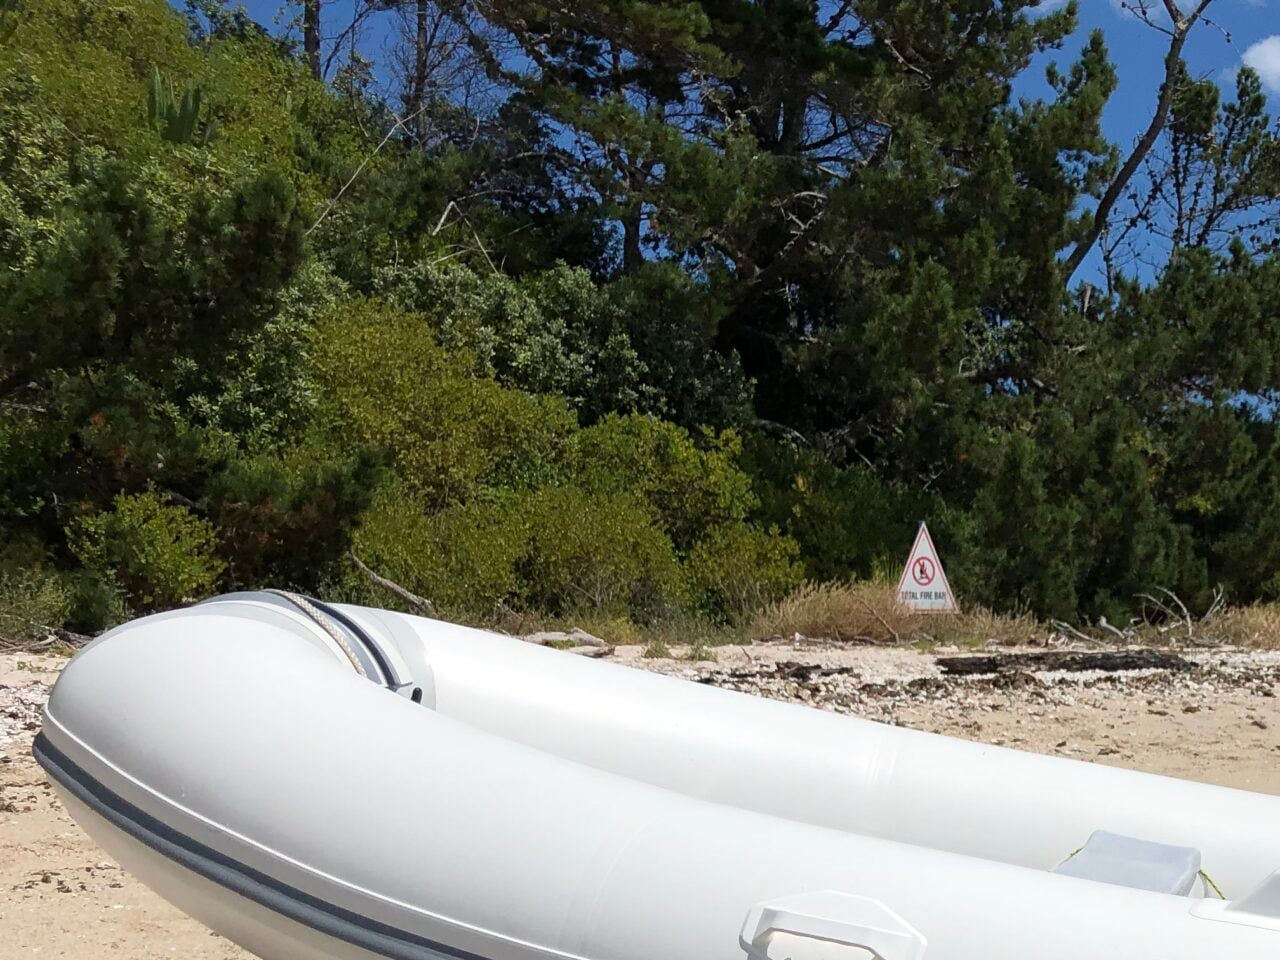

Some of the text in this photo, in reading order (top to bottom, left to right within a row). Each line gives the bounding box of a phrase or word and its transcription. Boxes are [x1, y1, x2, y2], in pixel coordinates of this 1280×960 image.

[901, 591, 947, 600] TOTAL FIRE BAN
